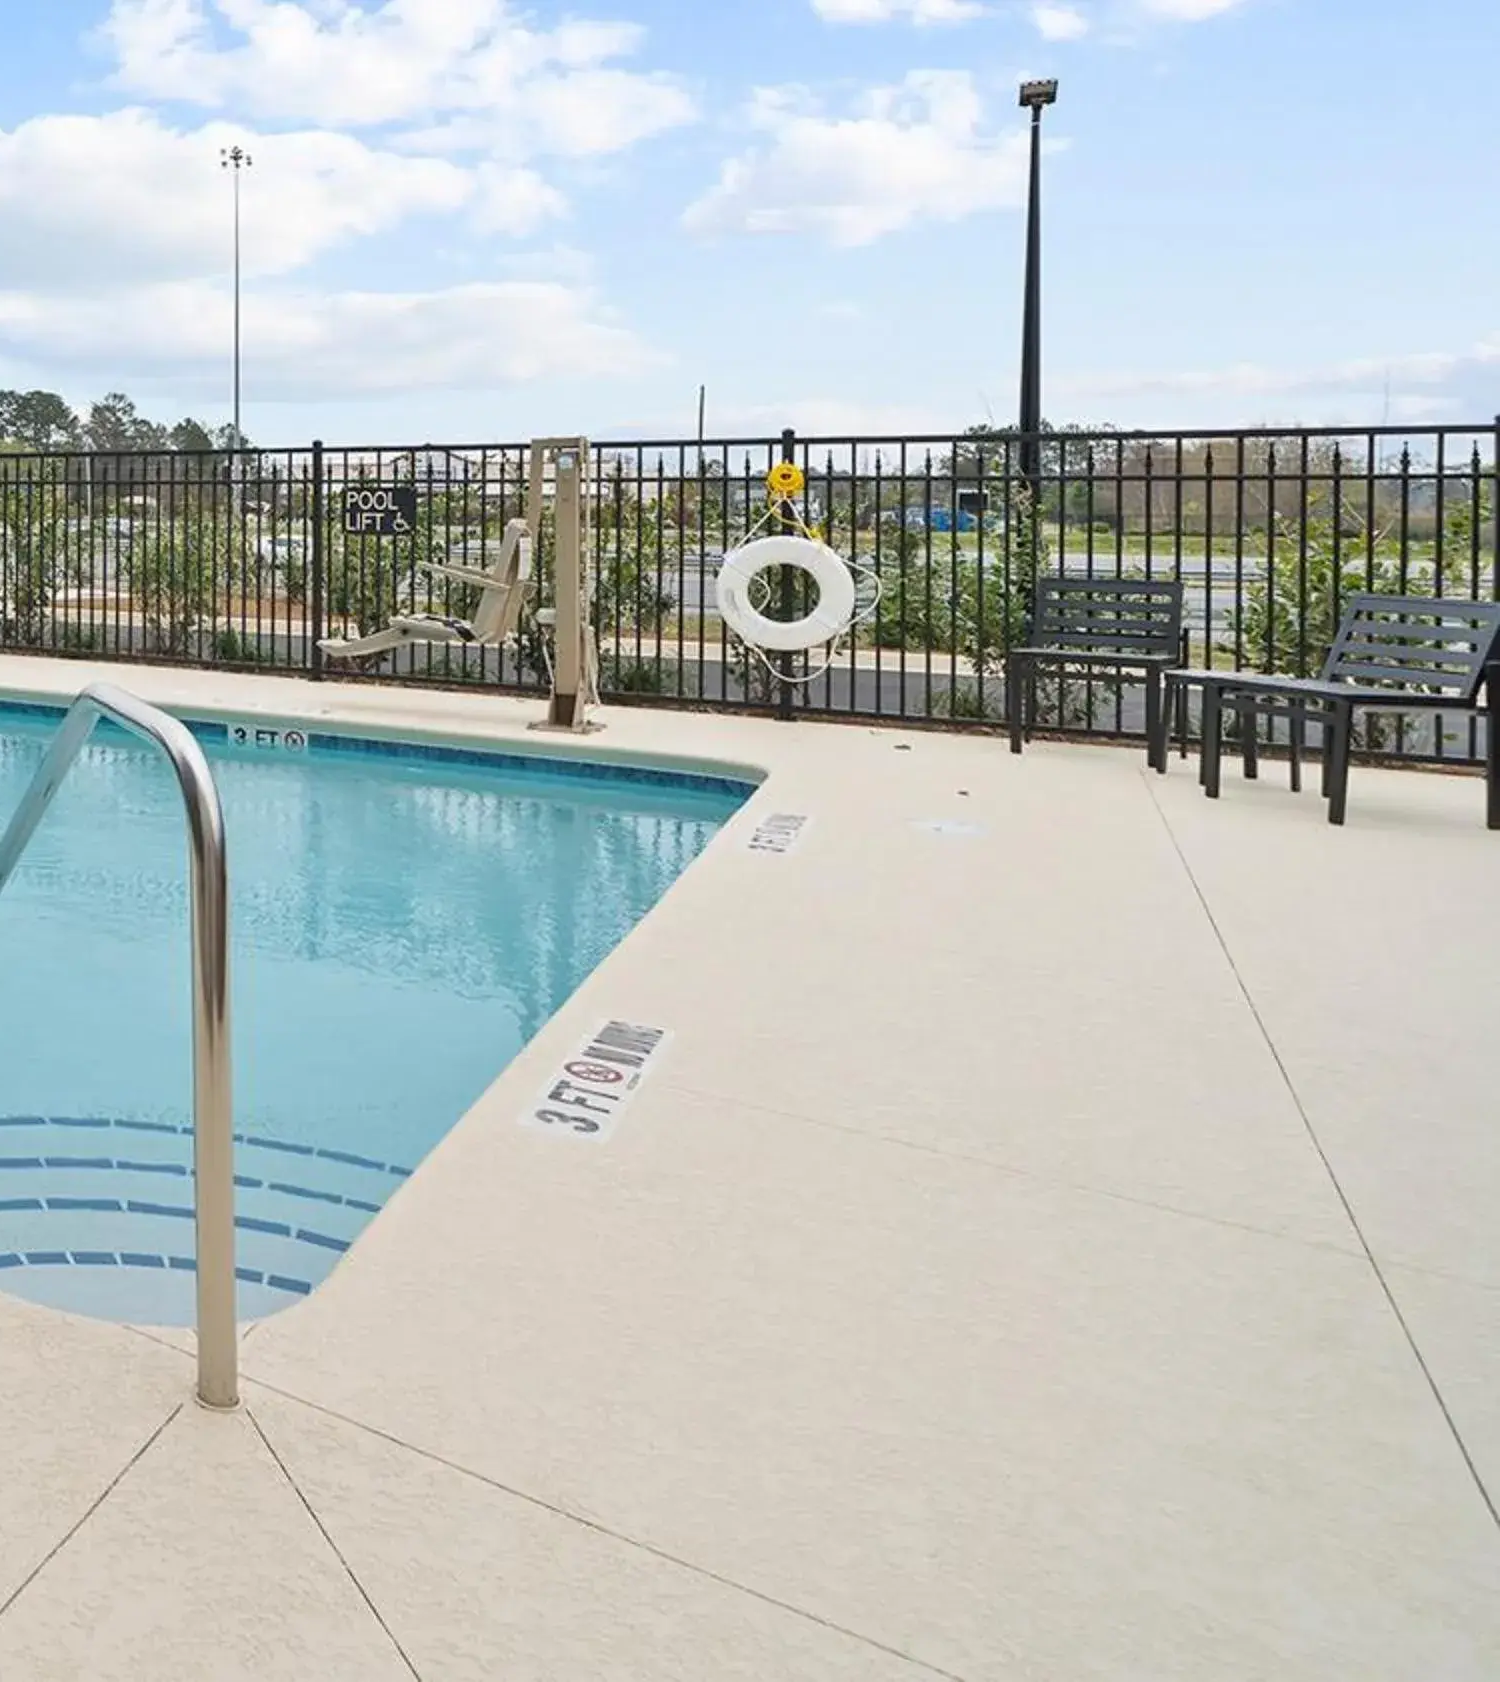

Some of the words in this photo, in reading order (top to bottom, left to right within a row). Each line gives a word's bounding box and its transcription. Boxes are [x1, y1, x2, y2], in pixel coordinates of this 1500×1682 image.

[346, 490, 399, 511] POOL
[345, 511, 385, 531] LIFT
[233, 727, 247, 746] 3
[547, 1079, 620, 1114] FT
[534, 1108, 600, 1133] 3
